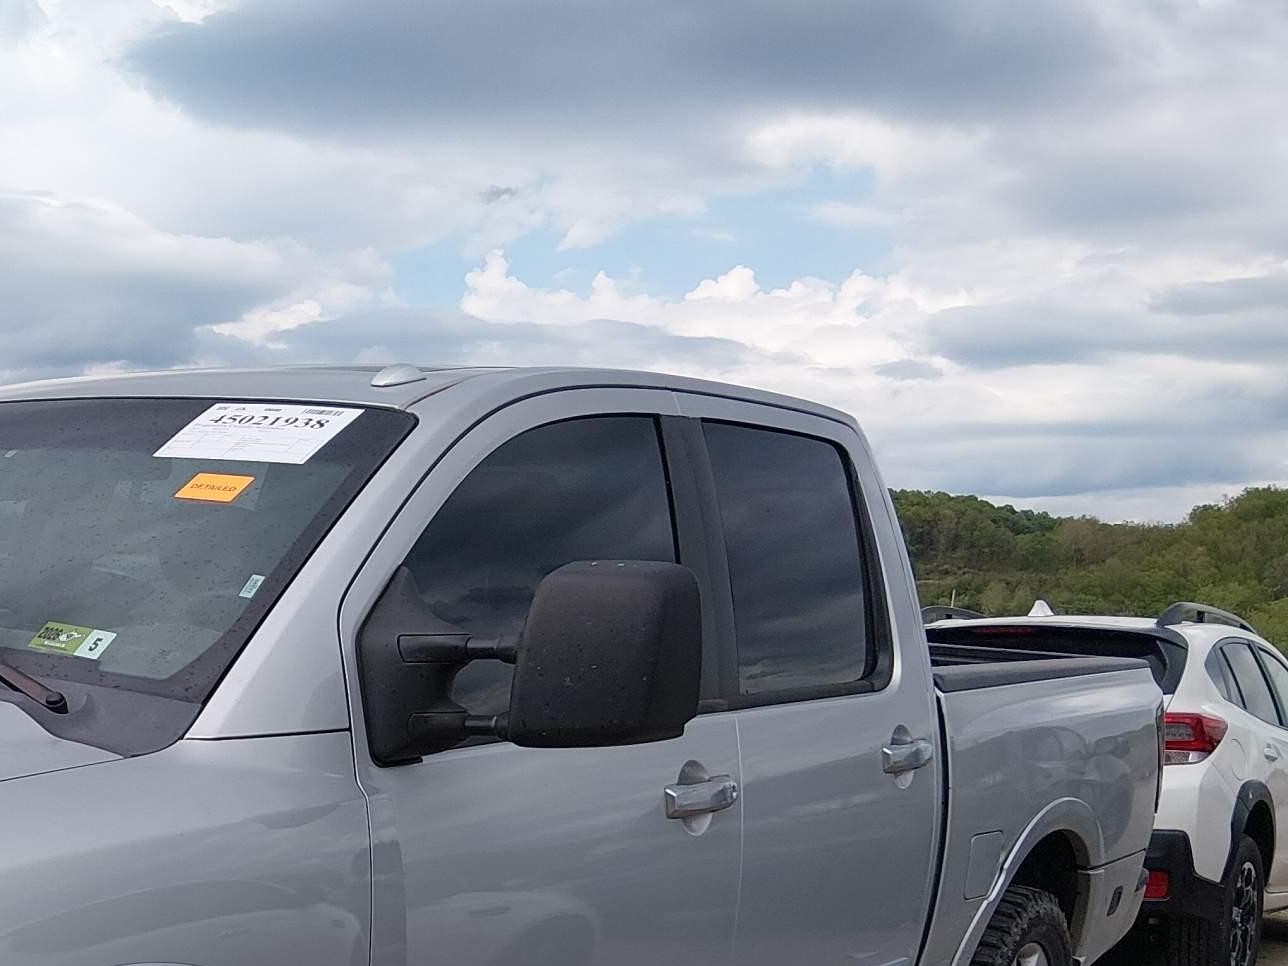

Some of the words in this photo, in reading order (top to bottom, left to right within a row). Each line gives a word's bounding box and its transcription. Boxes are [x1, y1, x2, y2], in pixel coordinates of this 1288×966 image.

[210, 414, 329, 430] 45021938
[190, 483, 237, 493] DETAILED
[88, 638, 103, 652] 5
